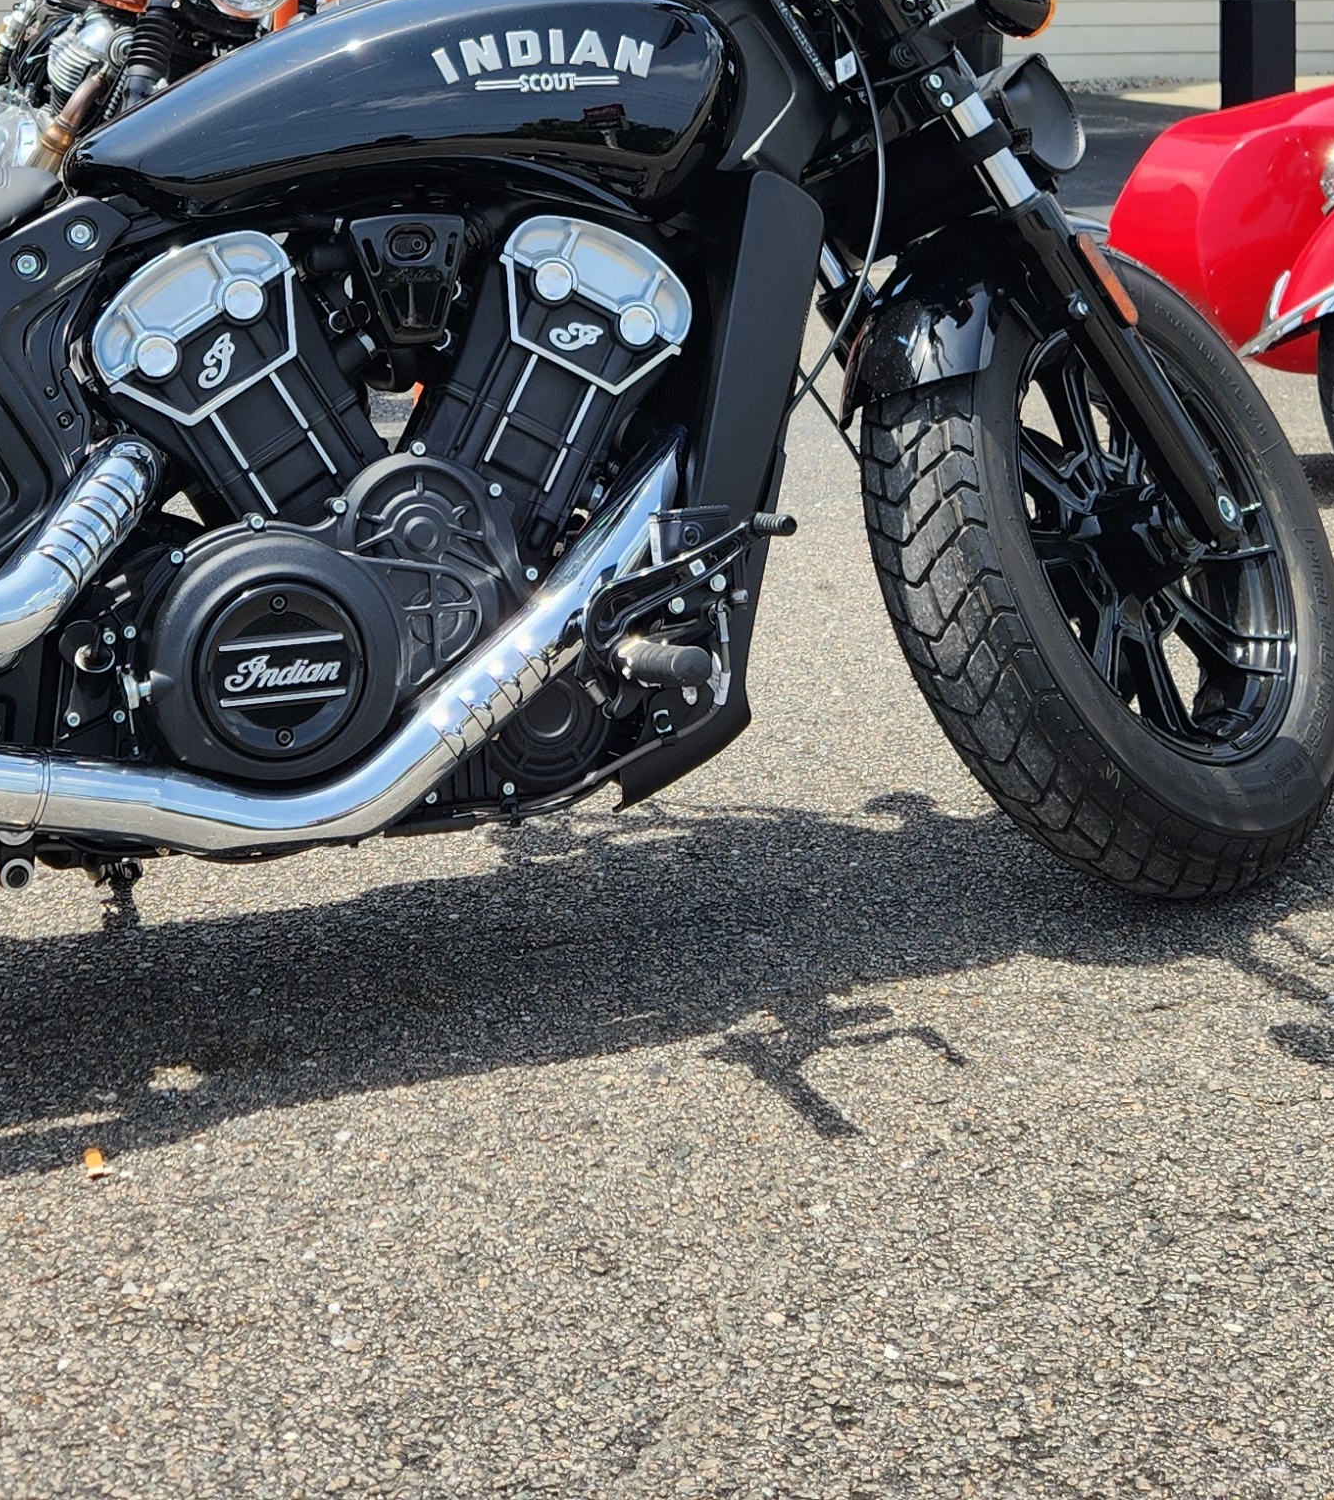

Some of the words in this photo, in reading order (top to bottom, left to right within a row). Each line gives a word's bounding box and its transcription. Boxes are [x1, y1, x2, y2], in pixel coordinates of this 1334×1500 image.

[431, 28, 654, 85] INDIAN
[519, 73, 576, 93] SCOUT
[224, 654, 341, 692] Indian
